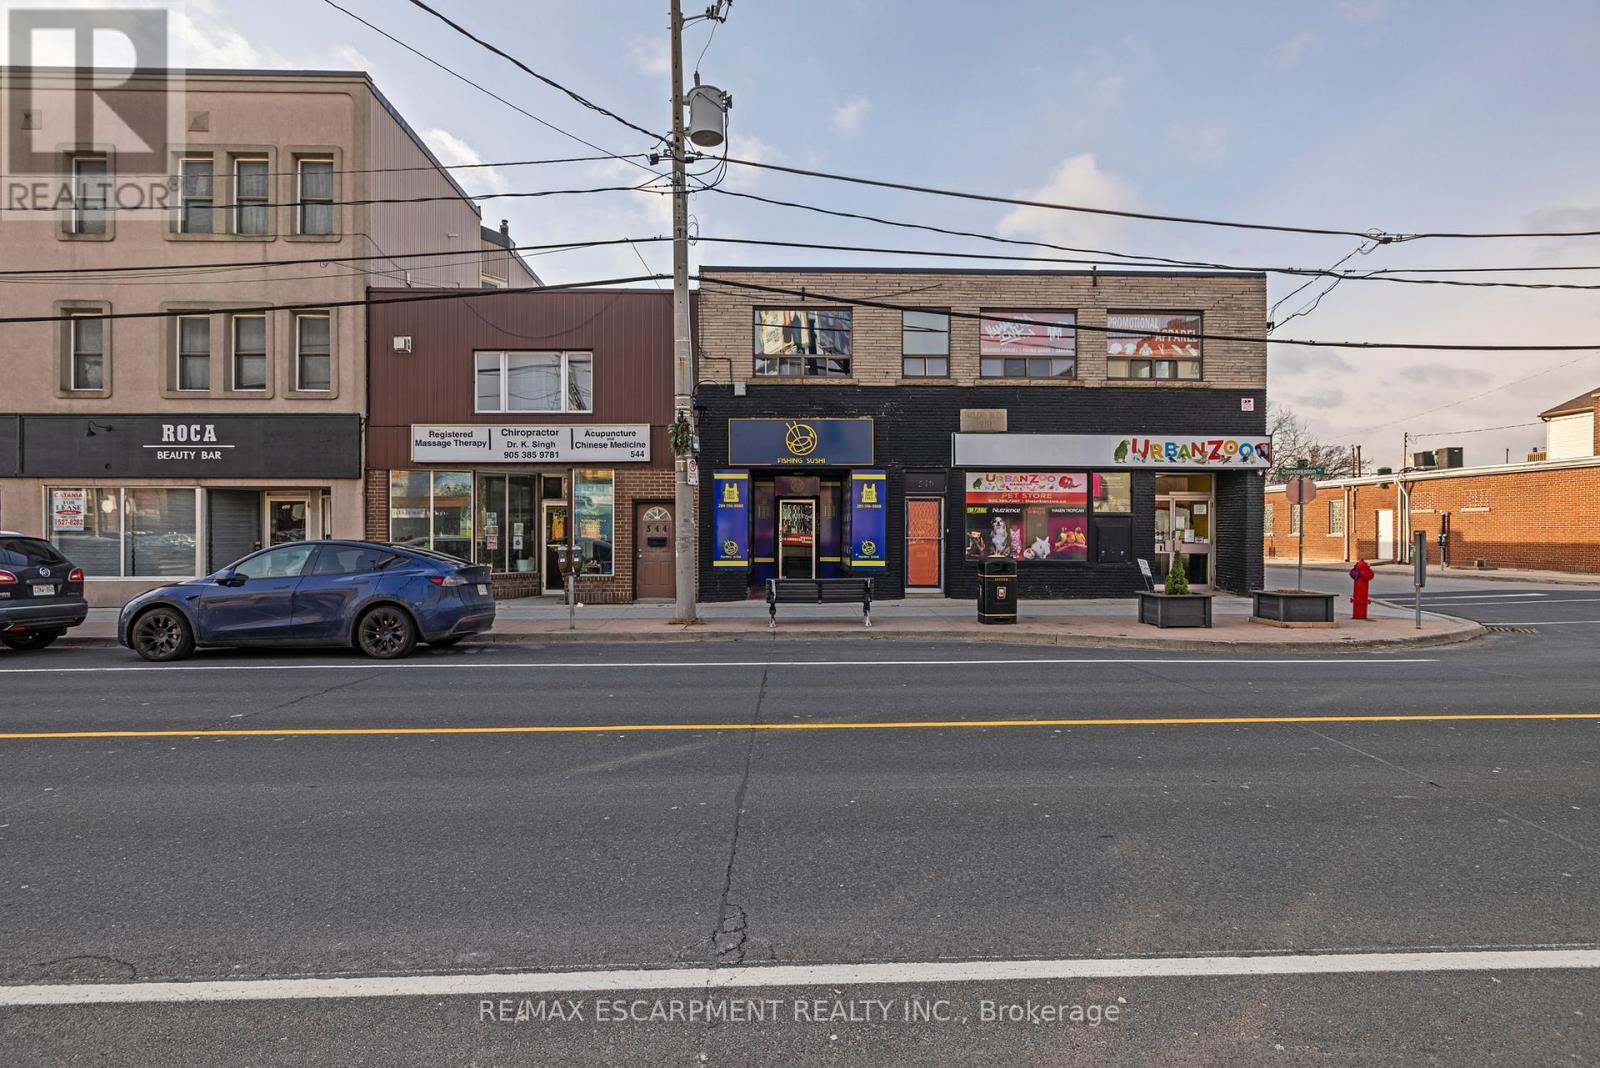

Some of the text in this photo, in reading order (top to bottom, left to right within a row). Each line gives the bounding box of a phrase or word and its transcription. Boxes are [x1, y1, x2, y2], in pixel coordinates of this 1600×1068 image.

[1107, 316, 1159, 329] PROMOTIONAL
[161, 424, 217, 442] ROCA
[428, 430, 473, 439] Registered
[501, 428, 559, 437] Chiropractor
[584, 430, 636, 439] Acupuncture
[415, 439, 487, 449] Massage Therapy
[532, 441, 556, 449] Singh
[575, 441, 646, 449] Chinese Medicine
[630, 450, 645, 458] 544
[1131, 438, 1254, 461] URBANZOO
[157, 451, 222, 460] BEAUTY BAR
[504, 451, 559, 459] 905 385 9781
[985, 474, 1056, 484] URBANZOO
